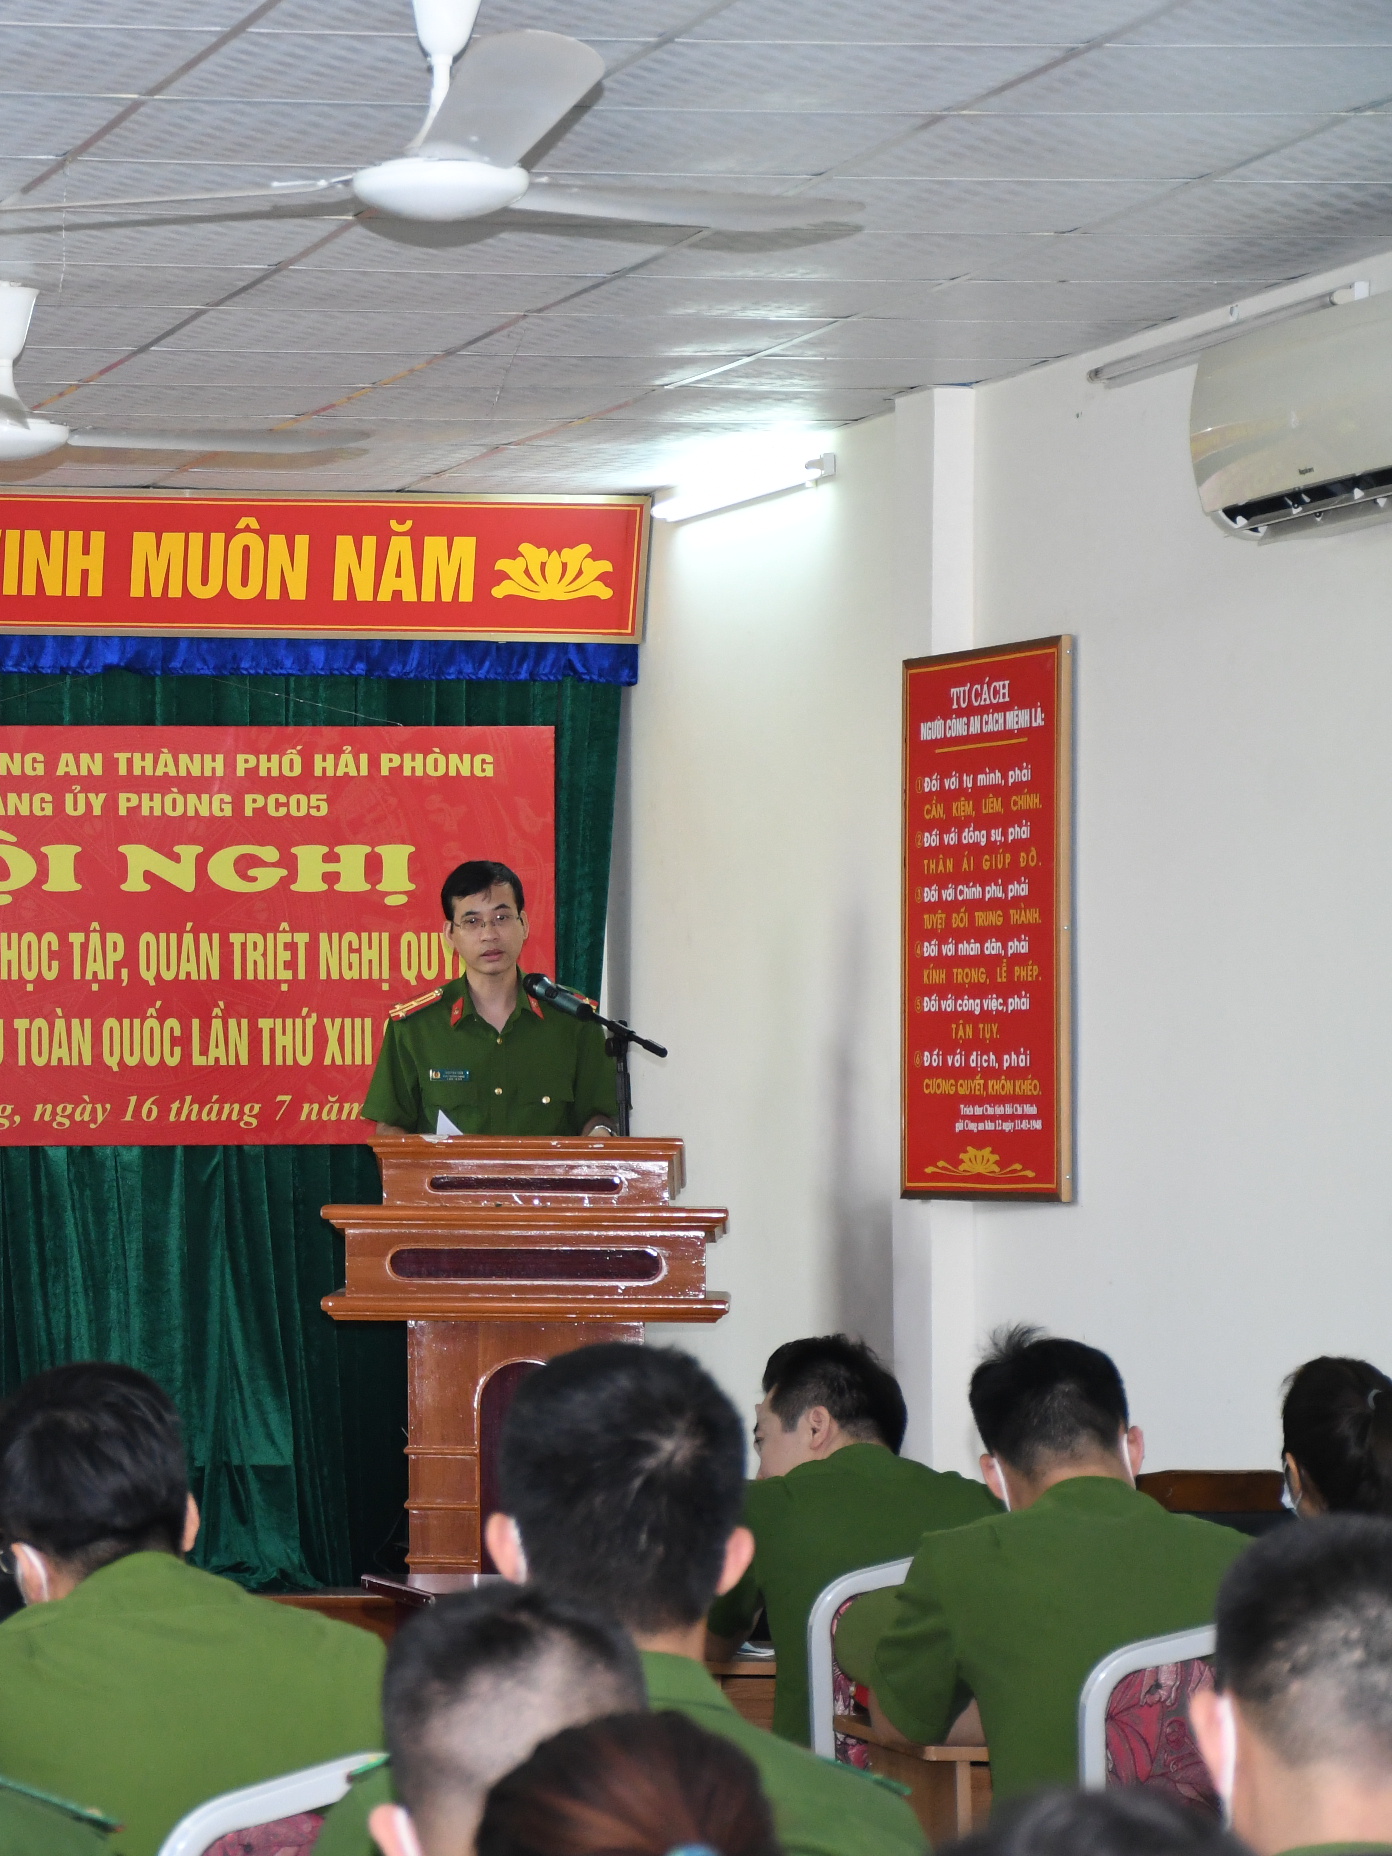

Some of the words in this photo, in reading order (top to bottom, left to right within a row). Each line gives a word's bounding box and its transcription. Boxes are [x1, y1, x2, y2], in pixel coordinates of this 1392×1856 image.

[130, 516, 309, 601] MUÔN
[333, 518, 476, 602] NĂM
[951, 683, 970, 708] TƯ
[972, 677, 1009, 706] CÁCH
[946, 715, 967, 737] CÔNG
[969, 715, 980, 734] AN
[983, 709, 1004, 732] CÁCH
[1006, 706, 1029, 733] MỆNH
[56, 753, 102, 776] AN
[114, 748, 224, 776] THÀNH
[236, 746, 302, 777] PHỐ
[314, 746, 368, 776] HẢI
[381, 748, 495, 777] PHÒNG
[924, 773, 940, 792] Đối
[945, 771, 958, 790] với
[963, 773, 973, 792] tự
[978, 768, 1004, 786] mình,
[1009, 763, 1031, 786] phải
[65, 785, 107, 816] ỦY
[118, 788, 232, 817] PHÒNG
[245, 794, 328, 817] PC05
[953, 797, 975, 820] KIỆM,
[983, 794, 1003, 813] LIÊM,
[1011, 789, 1042, 810] CHÍNH.
[924, 829, 939, 847] Đối
[944, 827, 957, 845] với
[962, 823, 986, 846] đồng
[991, 828, 1004, 845] sự,
[1009, 820, 1030, 843] phải
[118, 844, 416, 906] NGHỊ
[924, 855, 953, 874] THÂN
[962, 851, 973, 871] ÁI
[983, 849, 1011, 870] GIÚP
[924, 884, 938, 902] Đối
[942, 884, 954, 901] với
[957, 882, 982, 900] Chính
[986, 879, 1004, 901] phủ,
[1009, 877, 1028, 900] phải
[924, 910, 946, 933] TUYỆT
[952, 906, 968, 928] ĐỐI
[975, 910, 1003, 926] TRUNG
[1010, 903, 1041, 924] THÀNH.
[0, 932, 59, 991] HỌC
[69, 922, 128, 991] TẬP,
[139, 922, 219, 986] QUÁN
[229, 922, 309, 991] TRIỆT
[319, 932, 389, 990] NGHỊ
[924, 939, 938, 956] Đối
[942, 938, 955, 956] với
[959, 939, 980, 955] nhân
[985, 938, 1004, 956] dân,
[1008, 935, 1028, 957] phải
[924, 964, 945, 984] KÍNH
[953, 968, 989, 987] TRỌNG,
[1015, 961, 1041, 981] PHÉP.
[924, 994, 938, 1011] Đối
[941, 994, 954, 1011] với
[957, 996, 980, 1015] công
[983, 994, 1006, 1014] việc,
[1008, 991, 1029, 1013] phải
[14, 1008, 91, 1066] TOÀN
[102, 1001, 181, 1071] QUỐC
[192, 1001, 248, 1065] LẦN
[258, 1007, 317, 1066] THỨ
[324, 1018, 372, 1065] XIII
[952, 1020, 972, 1043] TẬN
[979, 1024, 999, 1043] TỤY.
[924, 1049, 942, 1066] Đối
[947, 1049, 964, 1067] với
[970, 1051, 998, 1071] địch,
[1004, 1048, 1030, 1070] phải
[924, 1078, 955, 1094] CƯƠNG
[989, 1076, 1013, 1095] KHÔN
[1016, 1075, 1041, 1095] KHÉO.
[34, 1095, 111, 1129] ngày
[124, 1096, 158, 1121] 16
[169, 1095, 261, 1128] tháng
[276, 1095, 292, 1120] 7
[301, 1096, 365, 1120] năm
